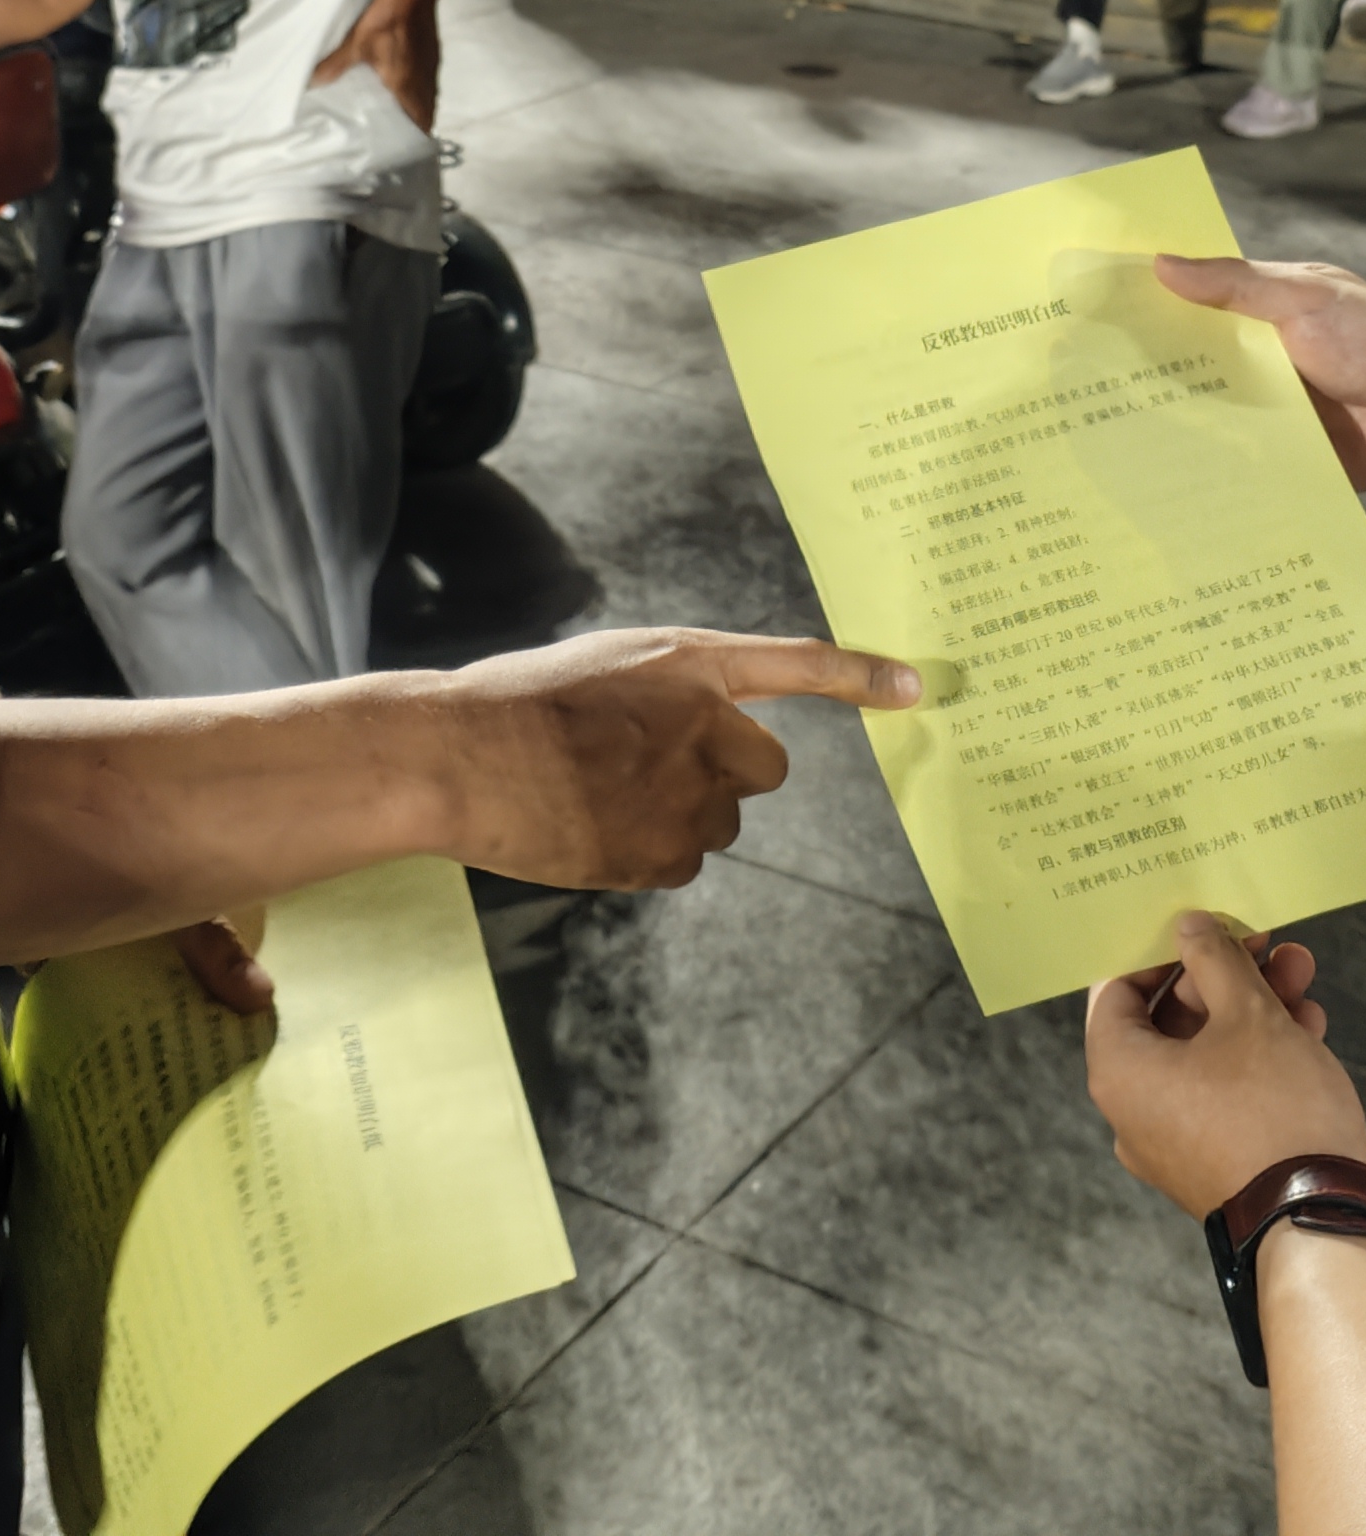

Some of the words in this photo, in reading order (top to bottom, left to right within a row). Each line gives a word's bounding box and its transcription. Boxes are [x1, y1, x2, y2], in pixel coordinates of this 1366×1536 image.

[920, 298, 1071, 352] 反邪教知识明白纸
[858, 396, 955, 428] 一、什么是邪教
[942, 589, 1100, 646] 三、我国有哪些邪教组织
[1037, 815, 1186, 871] 四、宗教与邪教的区别
